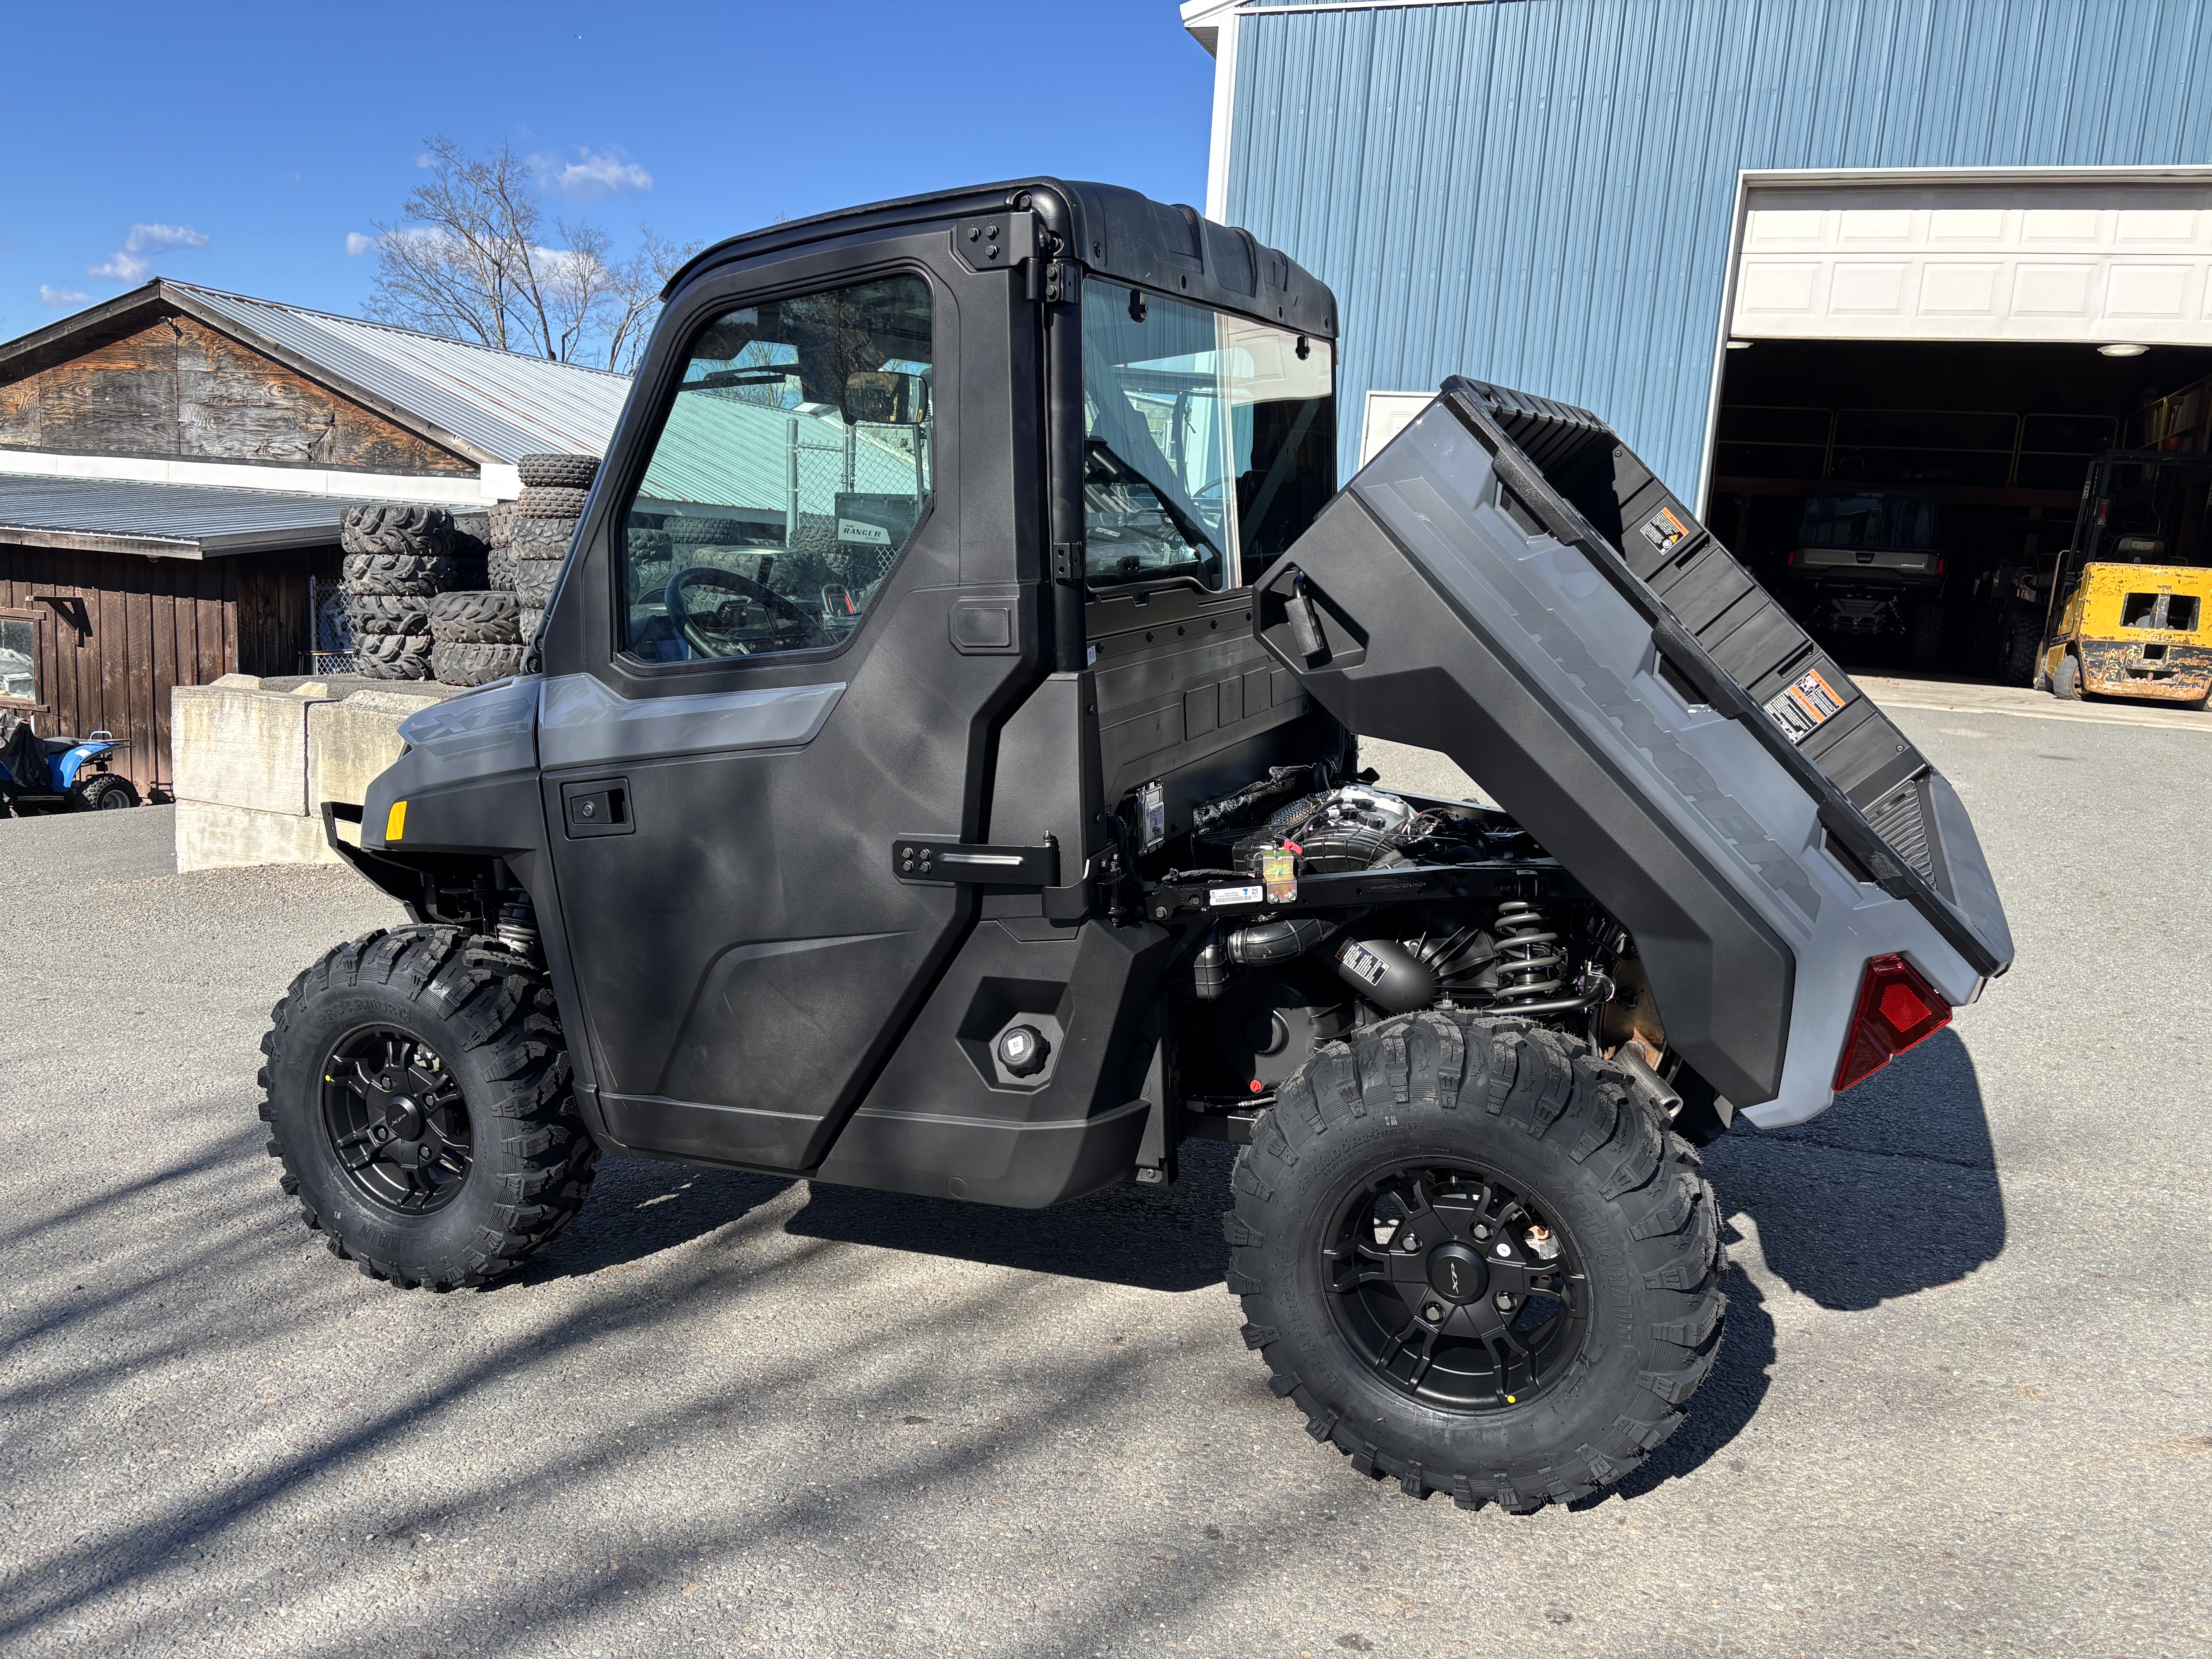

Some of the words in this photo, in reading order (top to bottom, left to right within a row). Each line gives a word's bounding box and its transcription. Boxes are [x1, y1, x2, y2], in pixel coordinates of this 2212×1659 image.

[843, 527, 881, 537] RANGER
[2145, 630, 2172, 642] Yale
[408, 697, 531, 742] XP
[1516, 608, 1822, 924] RANGER
[391, 1114, 407, 1127] XP
[357, 1223, 452, 1255] X-TERRAIN
[1553, 1178, 1634, 1341] X-TERRAIN
[1451, 1262, 1459, 1295] XP
